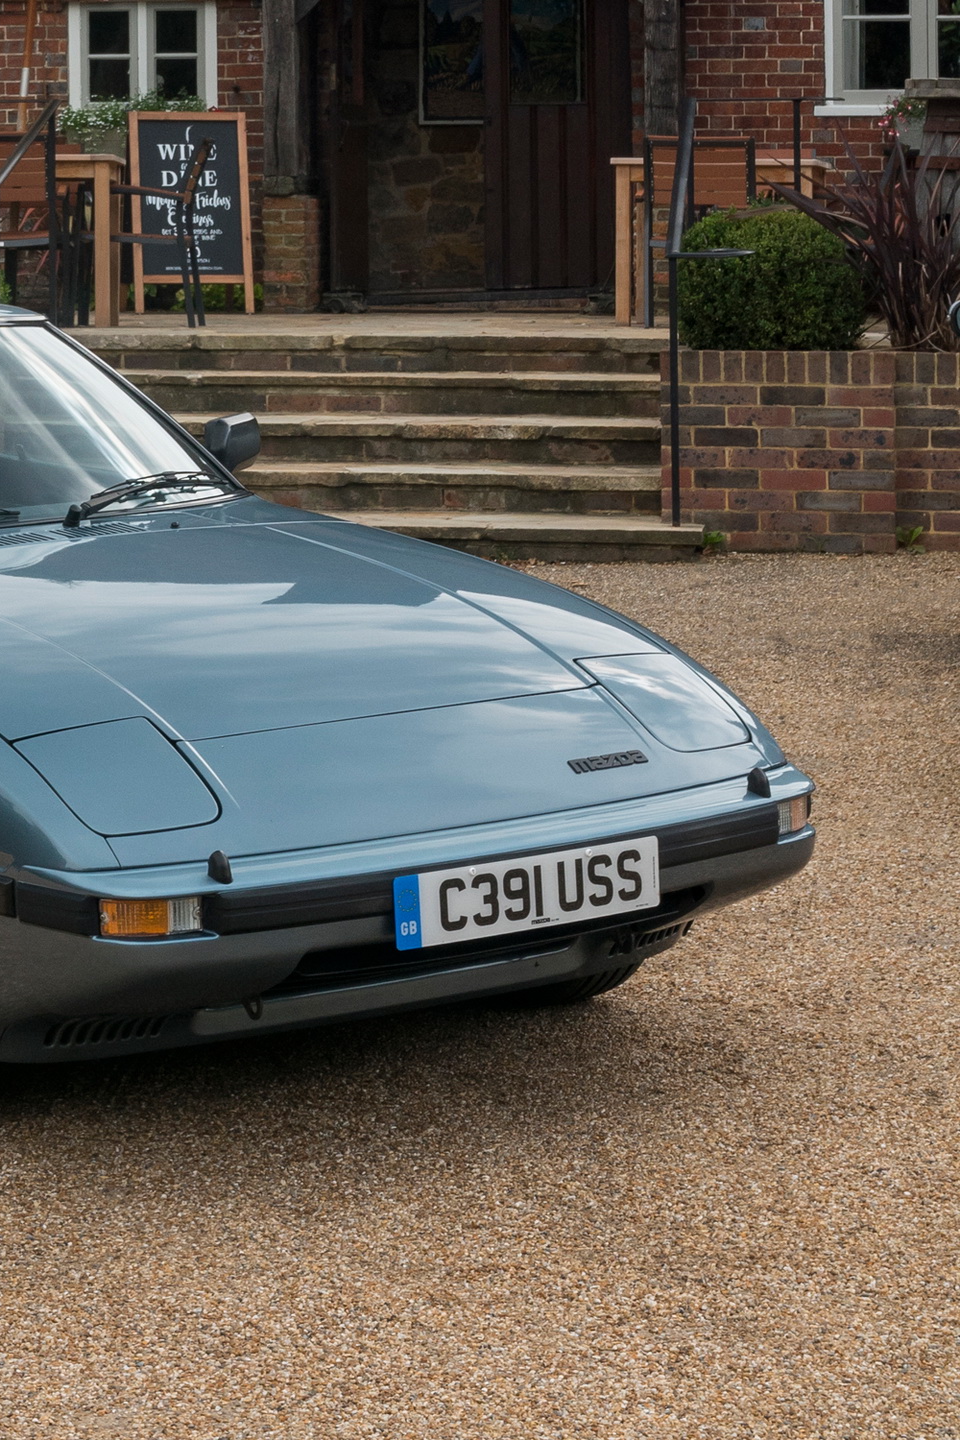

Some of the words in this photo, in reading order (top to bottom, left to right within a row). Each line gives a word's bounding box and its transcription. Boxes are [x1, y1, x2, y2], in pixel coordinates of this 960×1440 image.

[195, 189, 231, 210] Friday
[439, 865, 544, 932] C391
[557, 849, 642, 913] USS
[400, 920, 418, 936] GB
